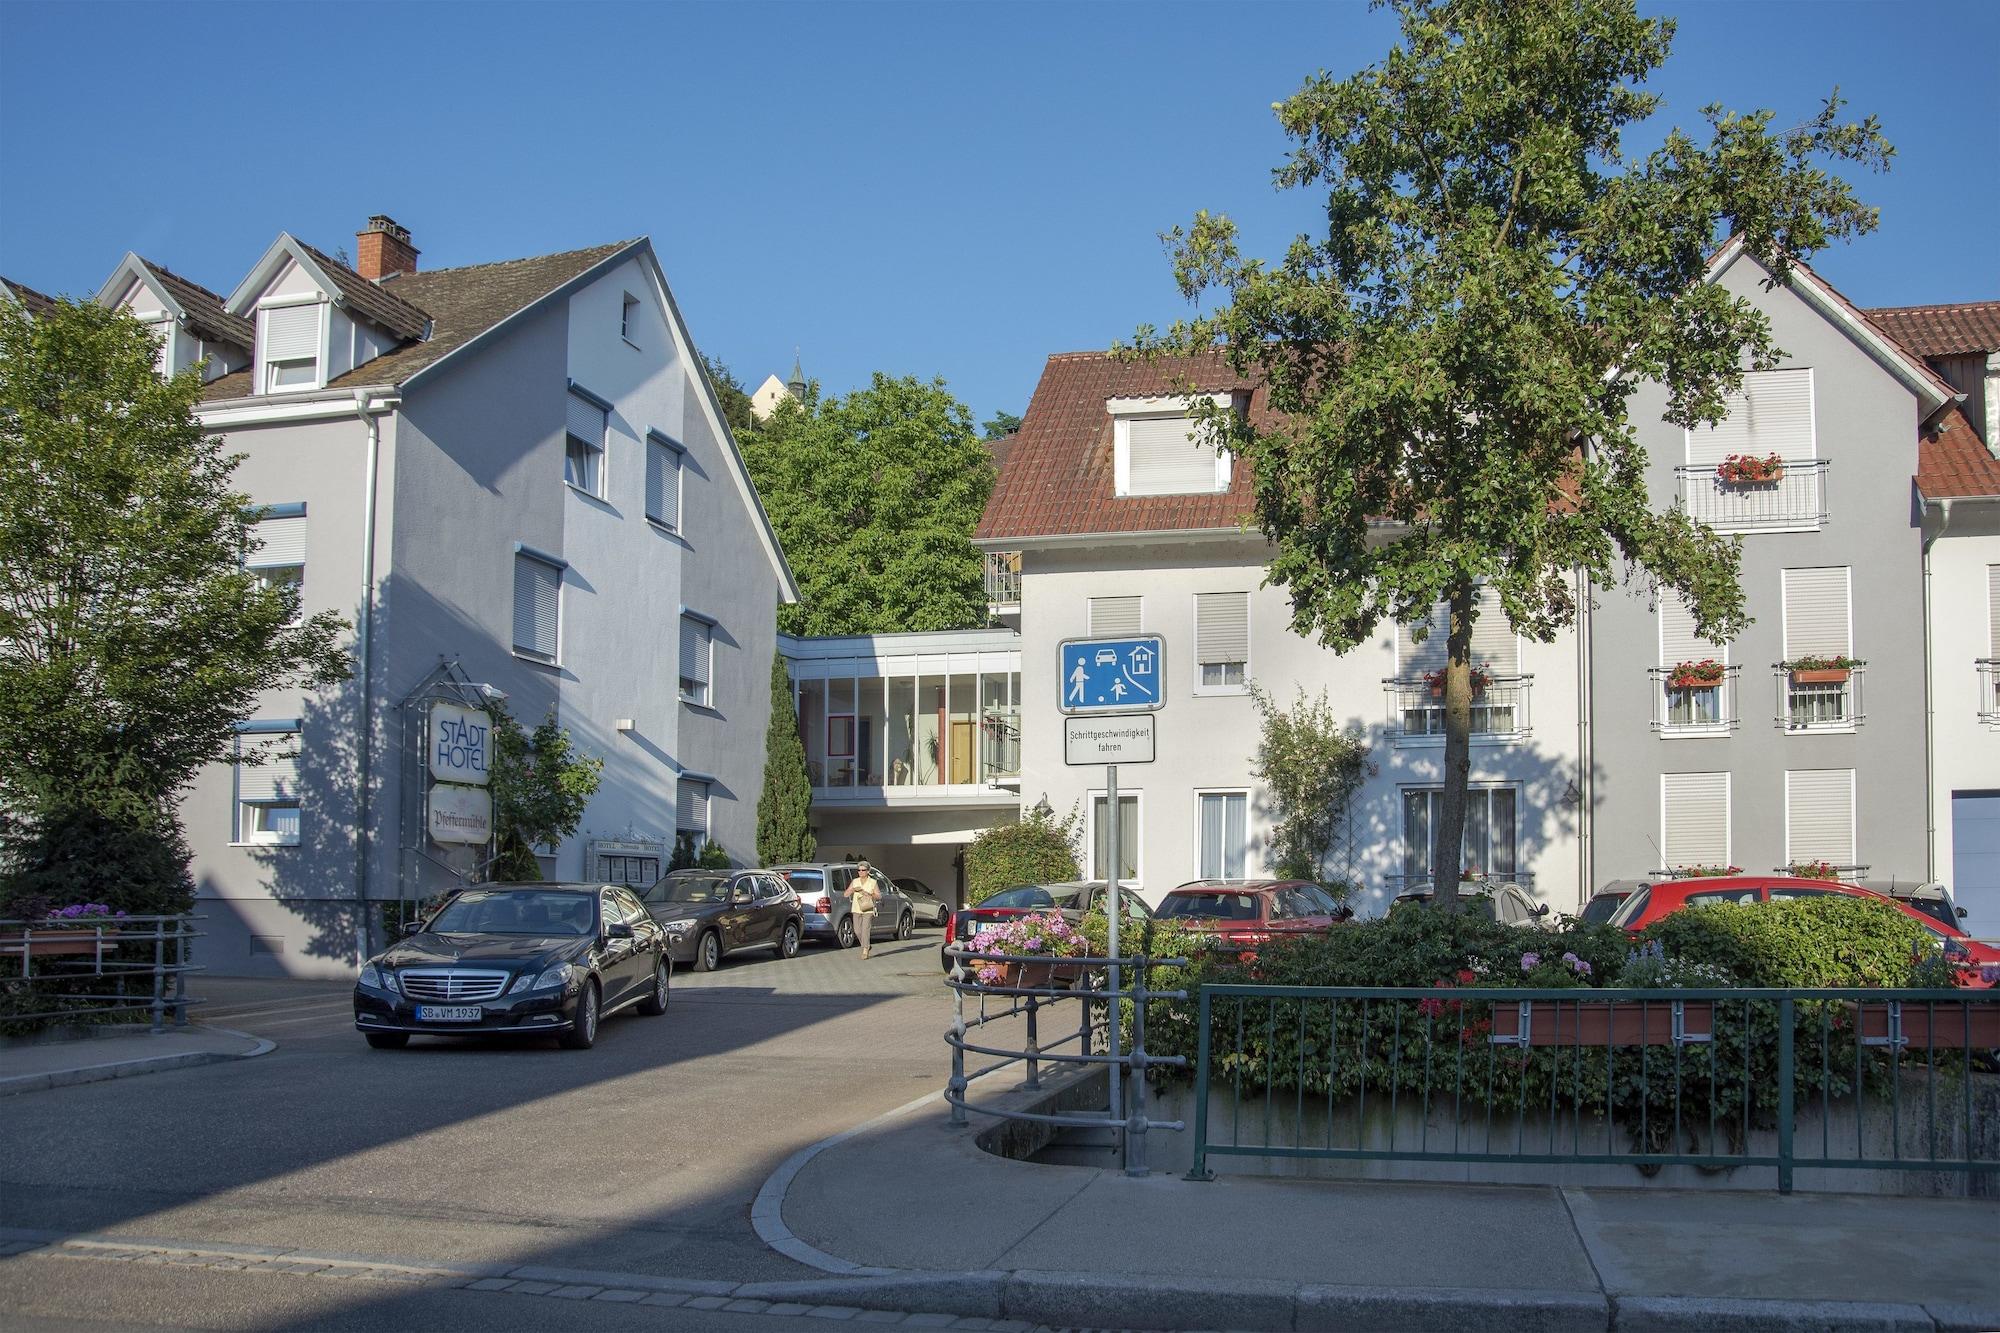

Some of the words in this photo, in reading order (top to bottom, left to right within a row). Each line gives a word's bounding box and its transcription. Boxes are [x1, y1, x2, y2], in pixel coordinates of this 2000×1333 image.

[440, 715, 488, 748] STADT
[1070, 728, 1150, 740] Schrittgeschwindigkeit
[1098, 742, 1122, 752] fahren
[438, 743, 489, 771] HOTEL
[433, 809, 487, 830] Pfeffermühle
[422, 1007, 434, 1018] SB
[455, 1007, 480, 1018] 1937
